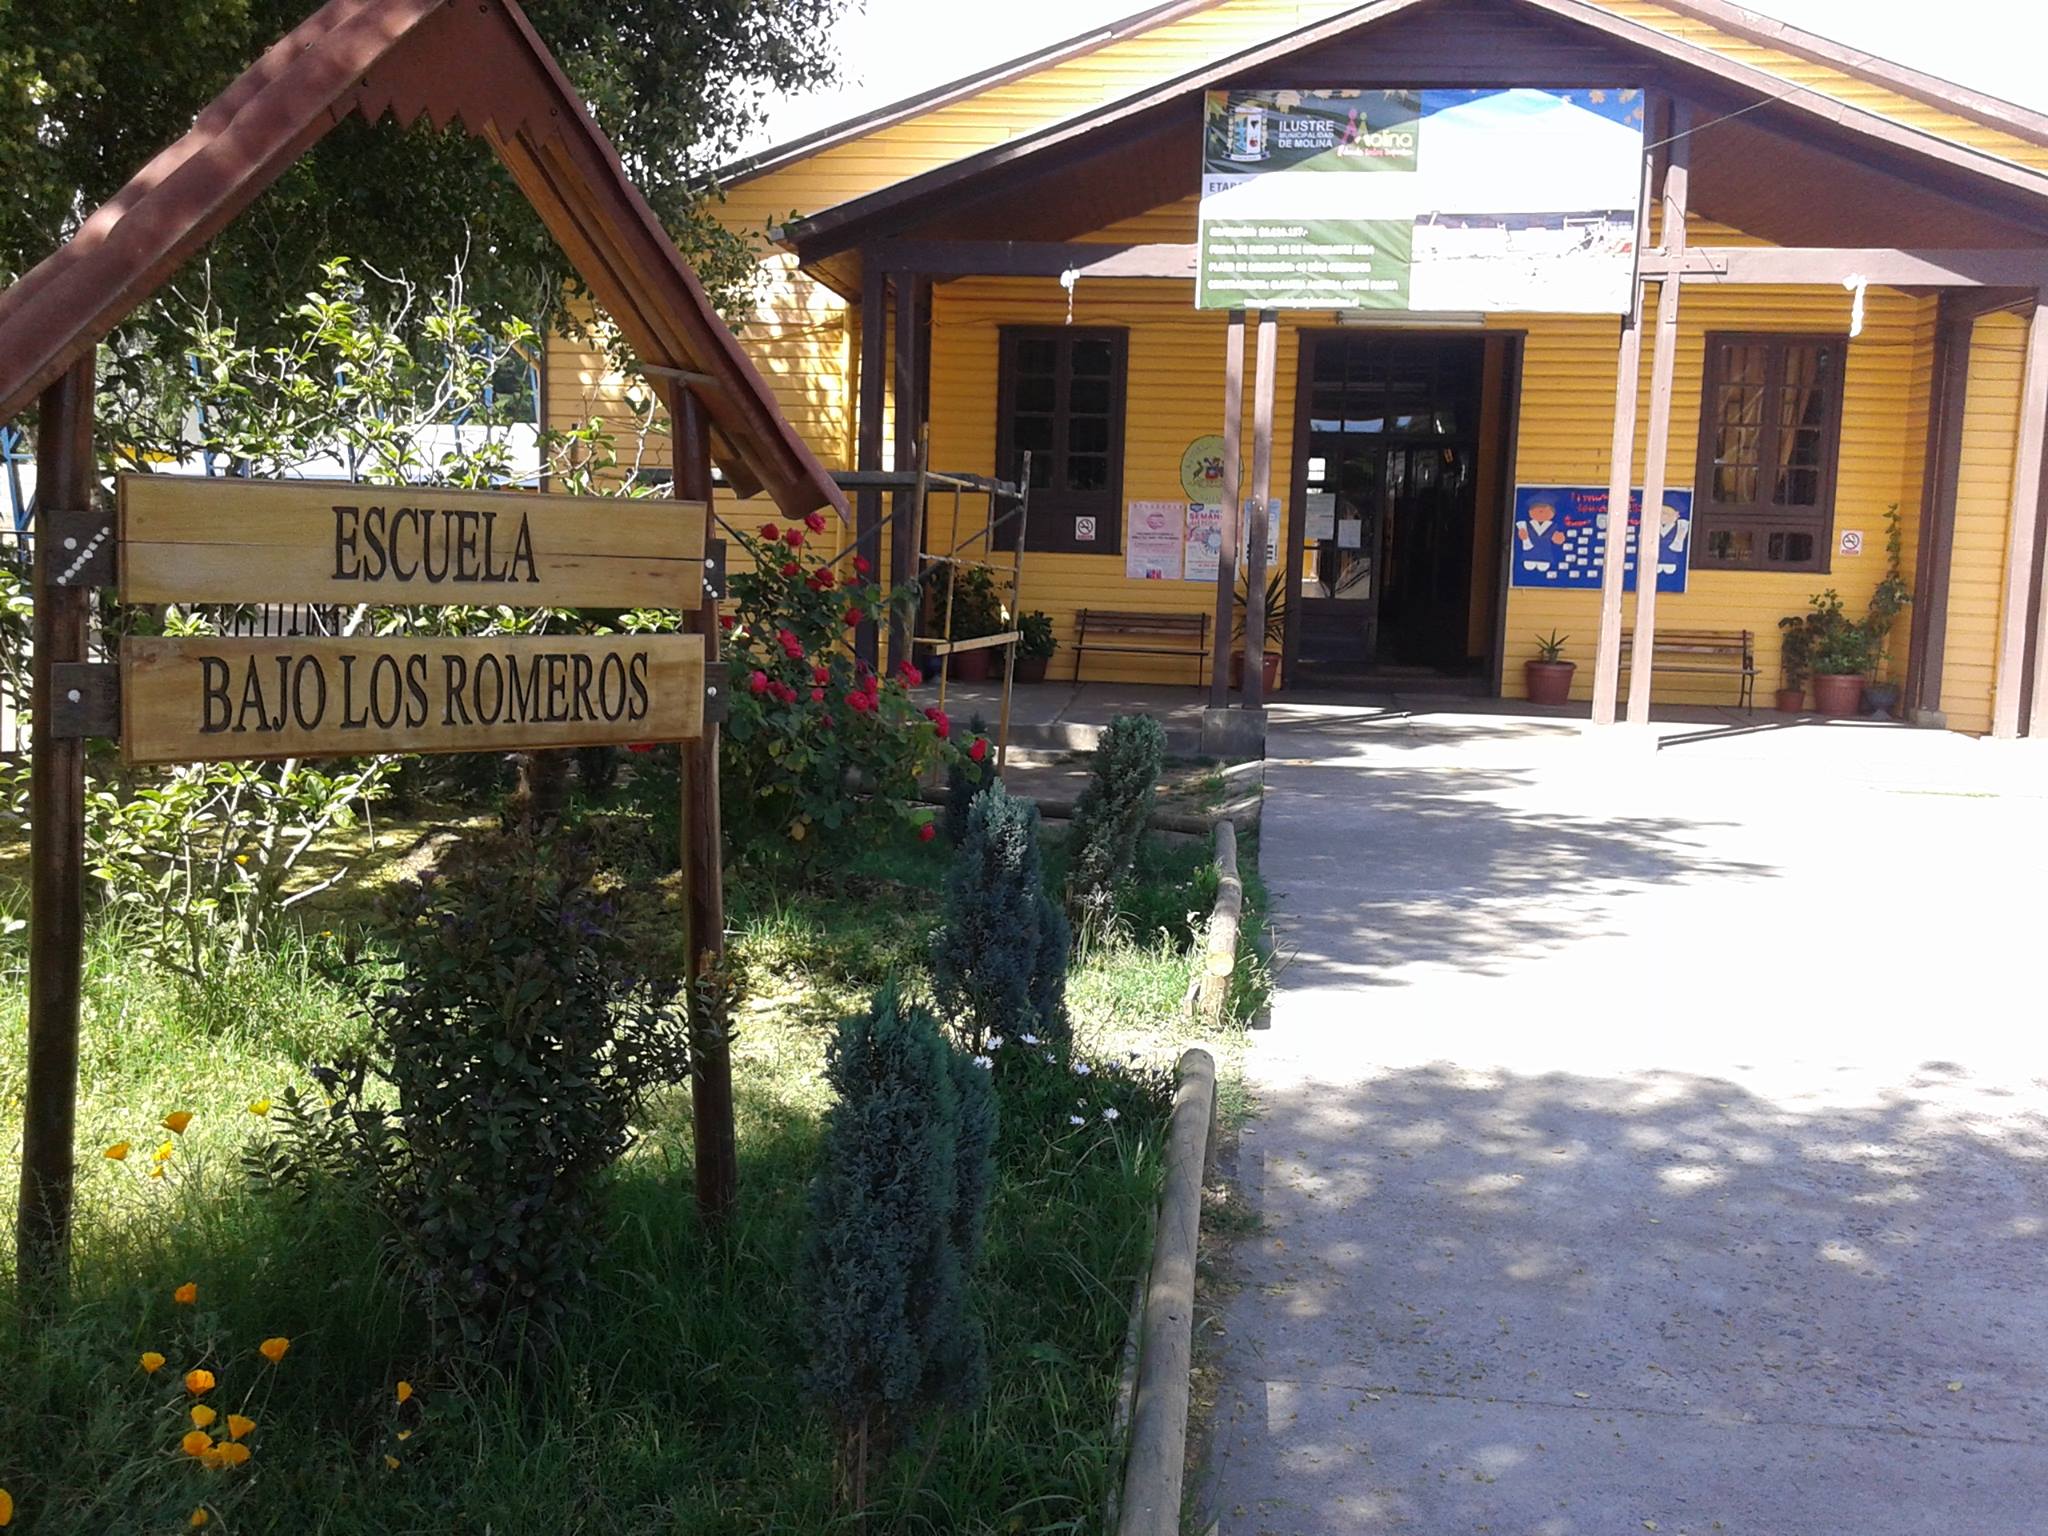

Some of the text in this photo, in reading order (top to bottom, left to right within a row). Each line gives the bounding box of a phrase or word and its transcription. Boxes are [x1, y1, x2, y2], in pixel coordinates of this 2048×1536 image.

[1278, 139, 1333, 148] DE MOLINA
[1279, 120, 1335, 131] ILUSTRE
[332, 506, 540, 583] ESCUELA
[200, 651, 649, 733] BAJO LOS ROMEROS
